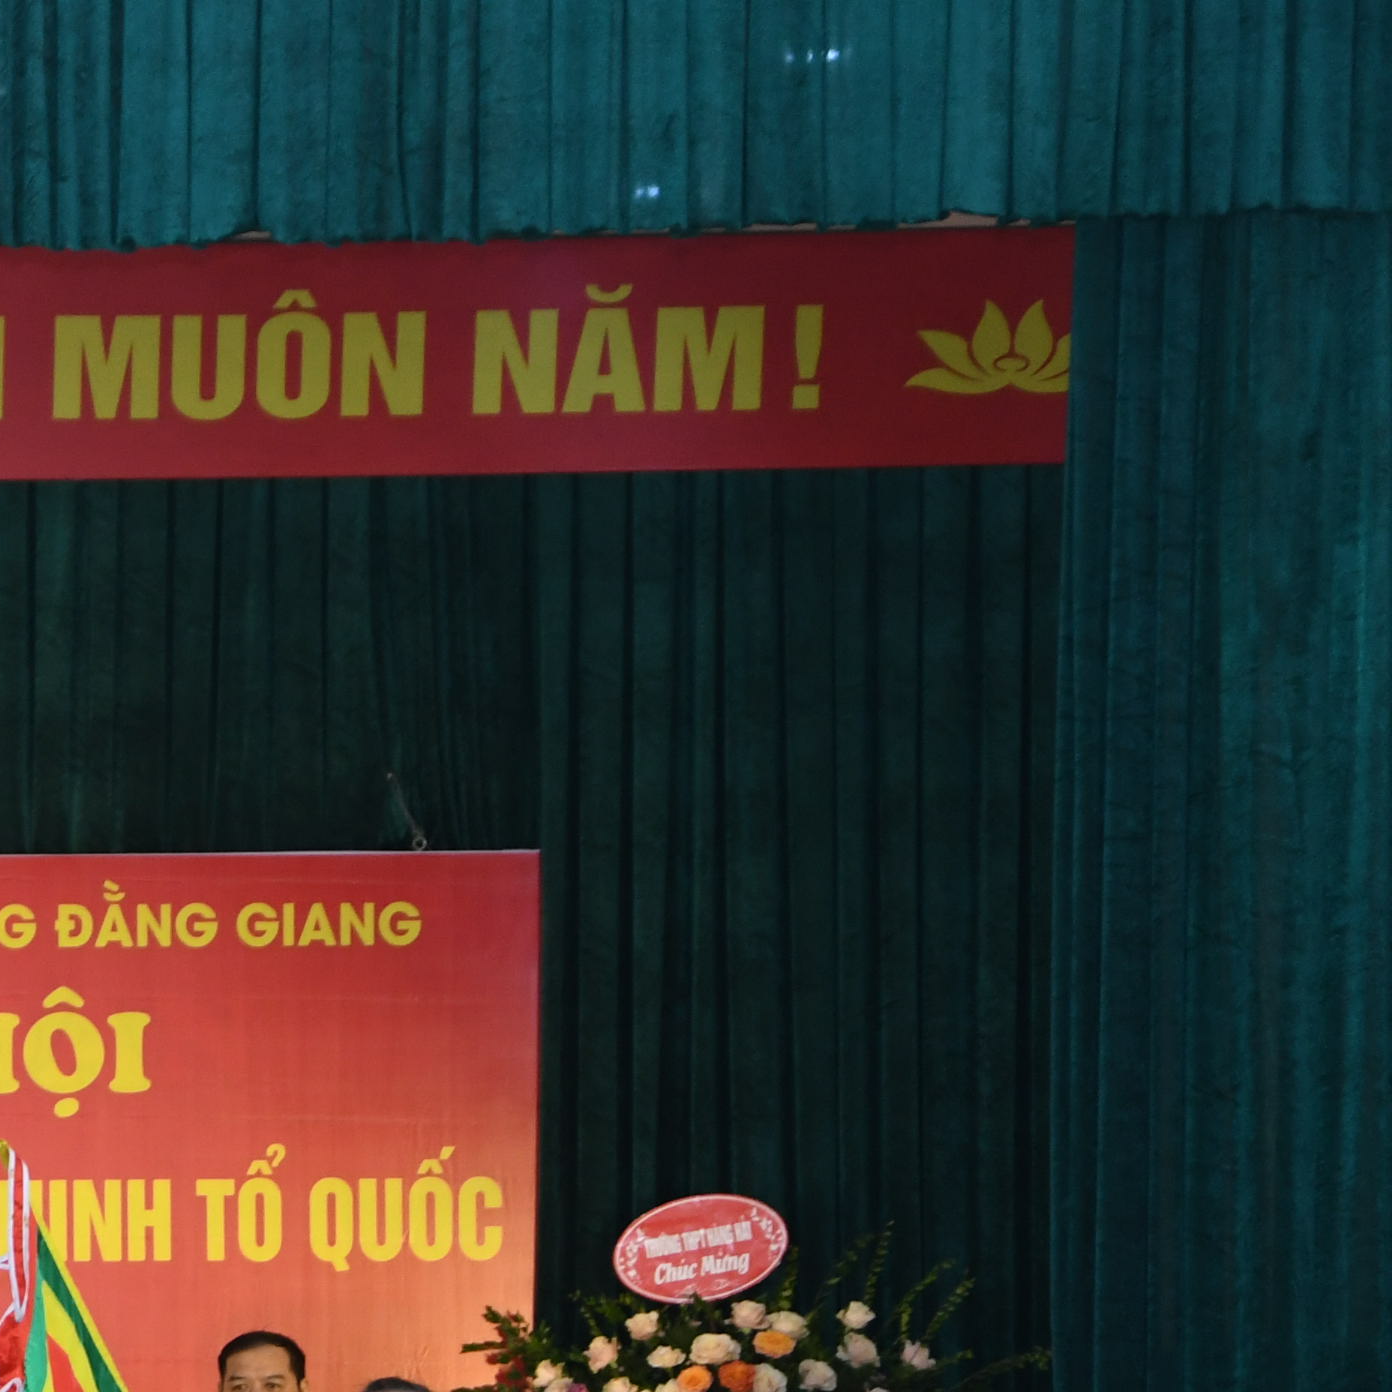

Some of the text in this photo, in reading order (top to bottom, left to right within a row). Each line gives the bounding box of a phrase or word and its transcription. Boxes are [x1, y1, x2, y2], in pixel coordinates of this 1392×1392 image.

[53, 290, 426, 420] MUÔN
[54, 880, 220, 949] ĐẰNG
[236, 901, 423, 948] GIANG
[194, 1141, 288, 1264] TỔ
[309, 1146, 504, 1272] QUỐC
[654, 1259, 697, 1284] Chúc
